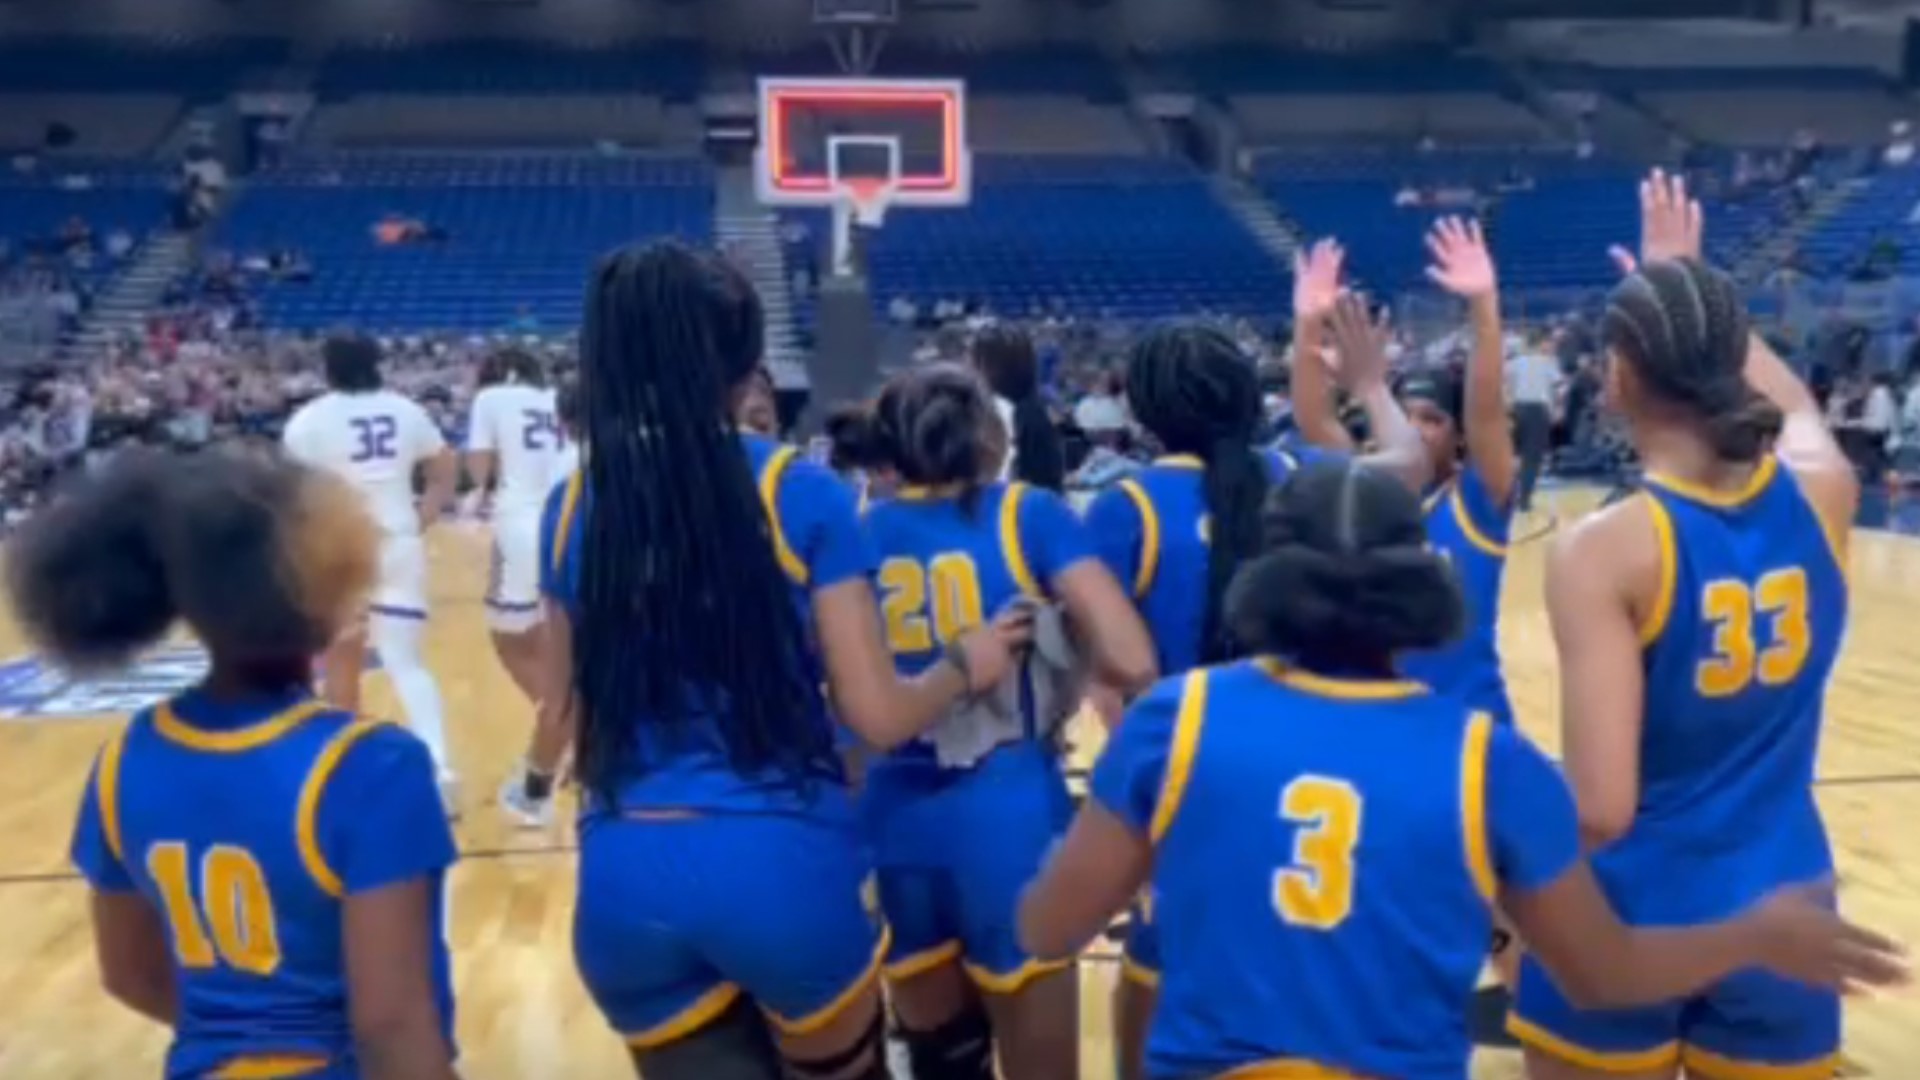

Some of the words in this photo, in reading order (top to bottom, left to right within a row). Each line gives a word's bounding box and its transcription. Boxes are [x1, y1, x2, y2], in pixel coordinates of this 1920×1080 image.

[349, 415, 396, 461] 32
[522, 408, 566, 450] 24
[878, 551, 981, 652] 20
[1696, 566, 1811, 696] 33
[146, 840, 281, 975] 10
[1270, 774, 1363, 930] 3
